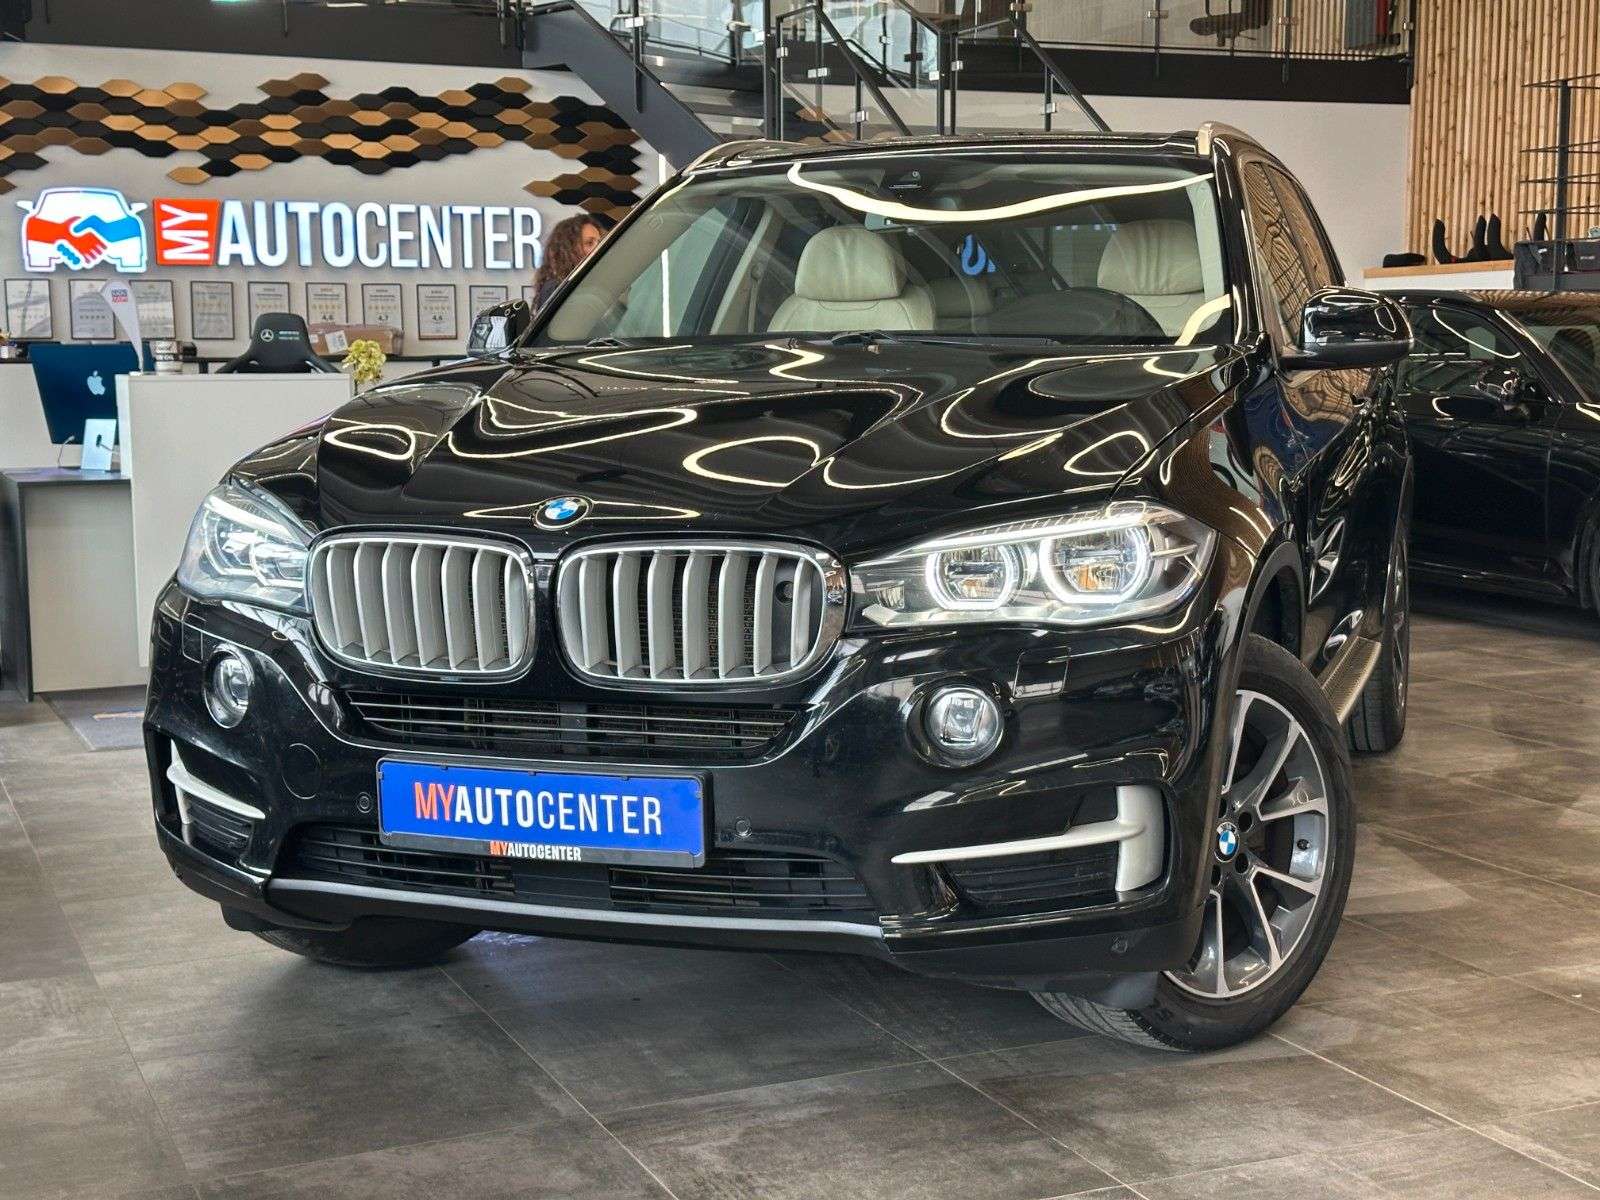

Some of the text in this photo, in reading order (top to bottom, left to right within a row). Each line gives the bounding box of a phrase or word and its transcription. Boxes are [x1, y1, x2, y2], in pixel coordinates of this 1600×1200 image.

[160, 201, 542, 269] MY AUTOCENTER
[414, 782, 662, 836] MYAUTOCENTER
[490, 840, 582, 862] MYAUTOCENTER
